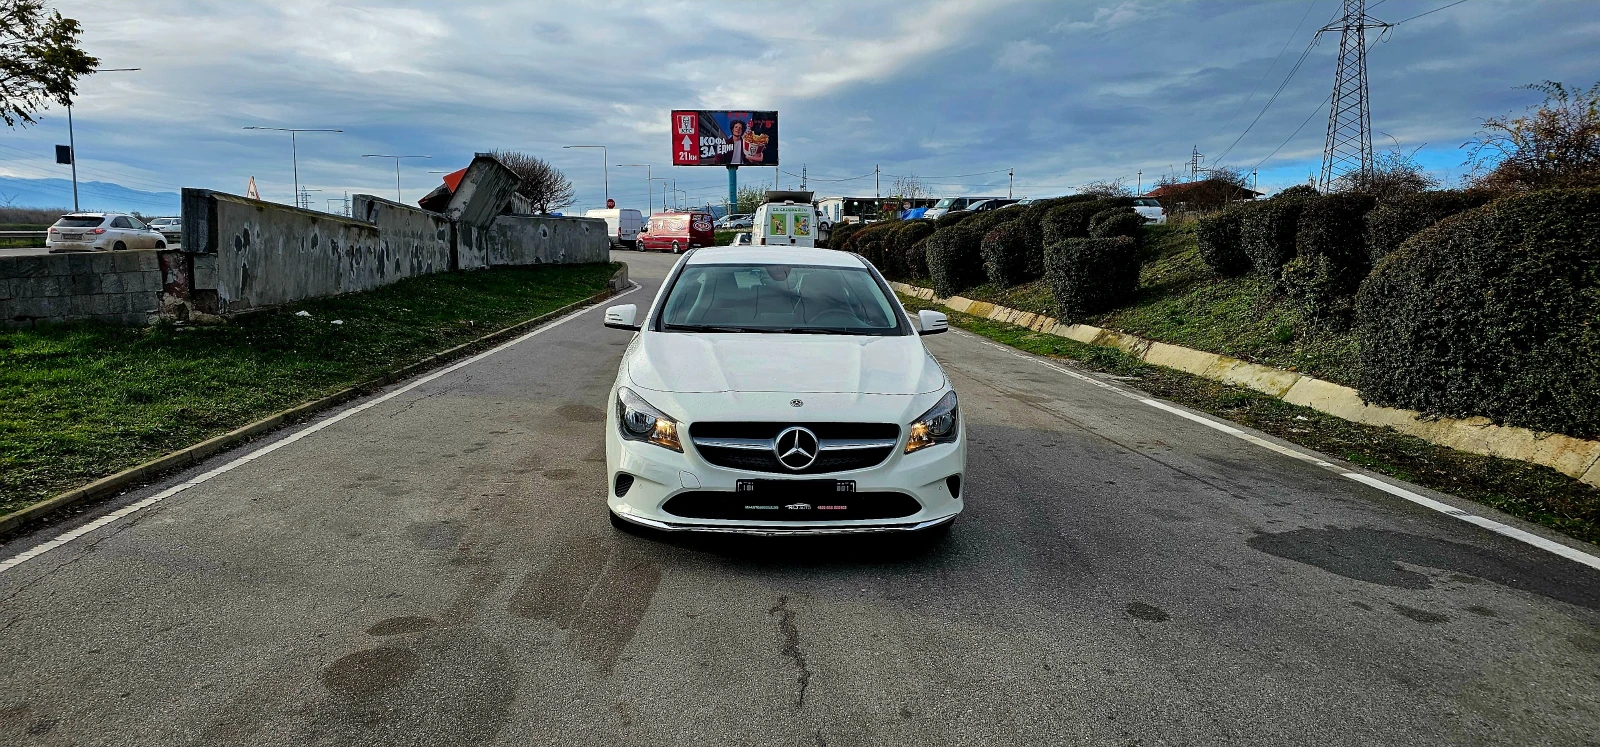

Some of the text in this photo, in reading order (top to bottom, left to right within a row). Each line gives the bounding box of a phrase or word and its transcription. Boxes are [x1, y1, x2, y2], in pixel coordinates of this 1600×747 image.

[700, 136, 726, 146] КОФА
[679, 151, 688, 160] 21
[700, 145, 715, 158] ЗА
